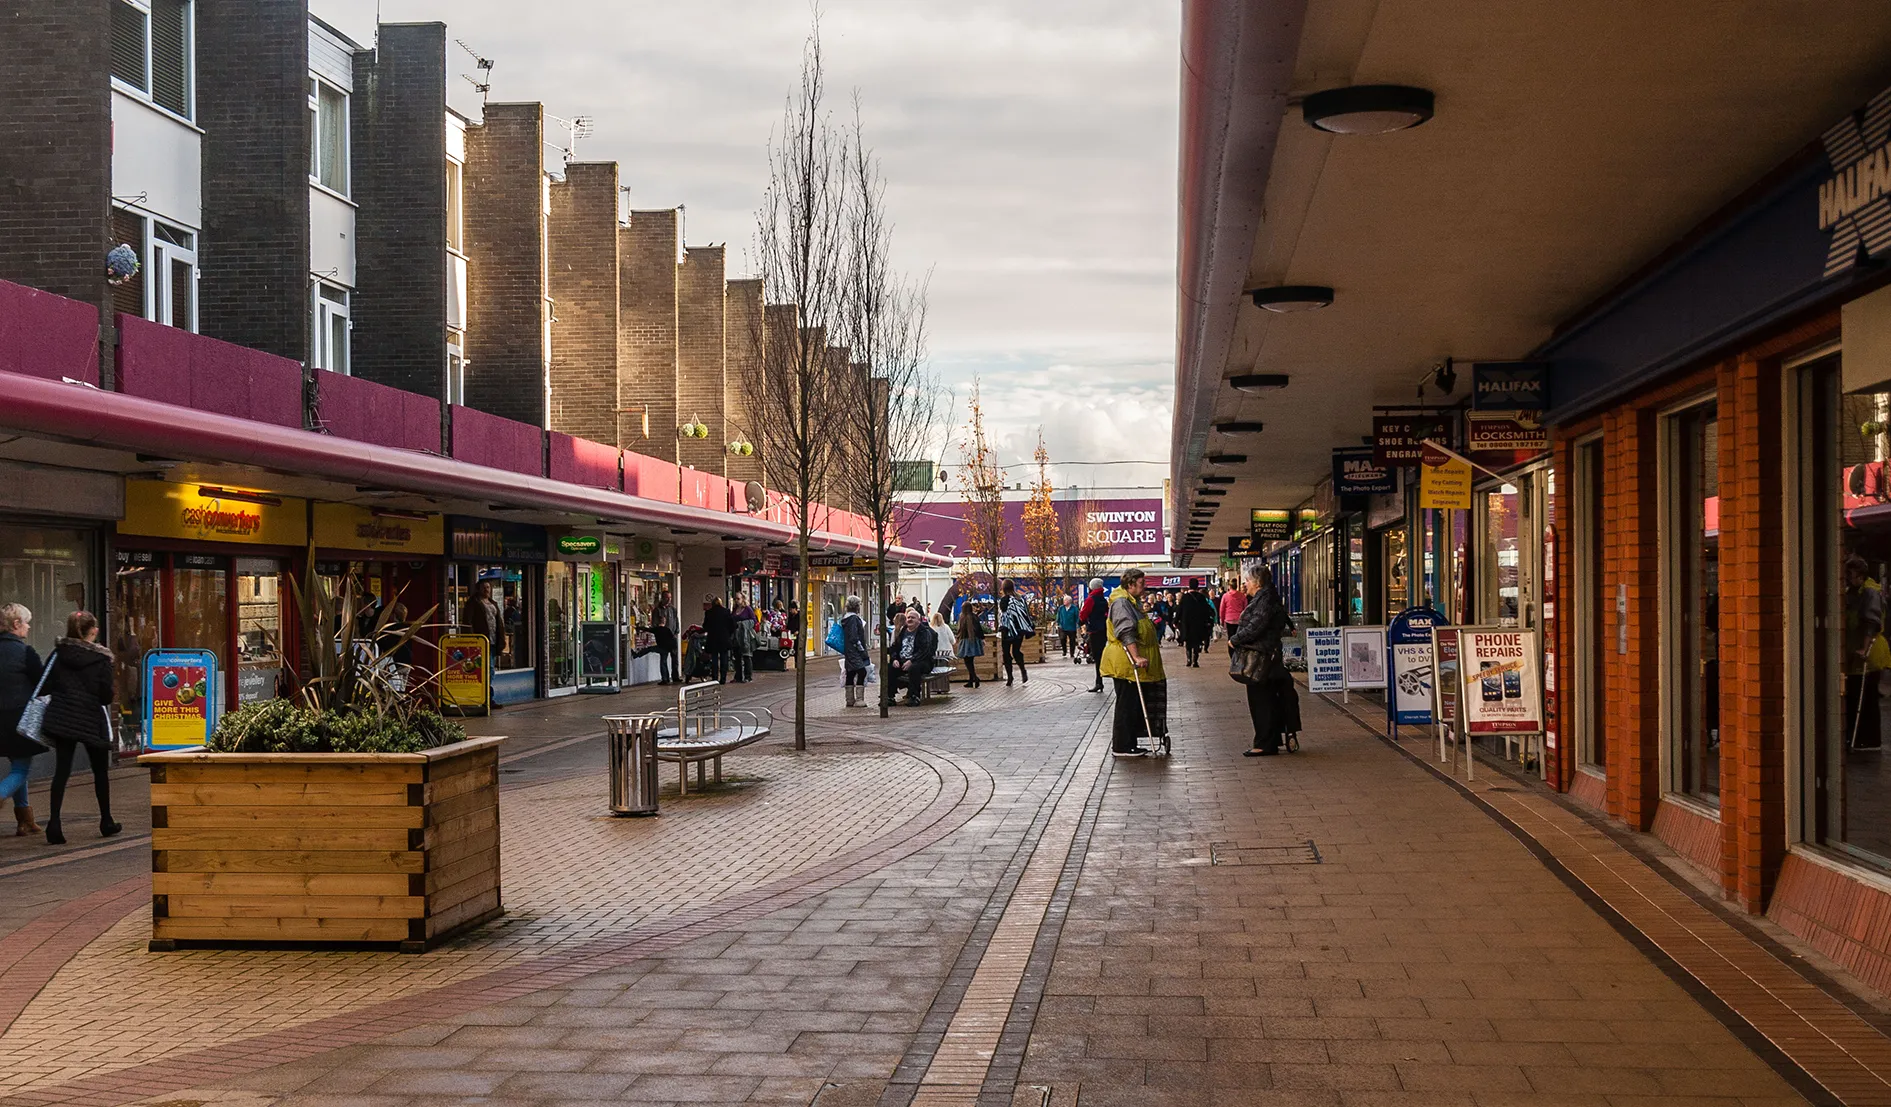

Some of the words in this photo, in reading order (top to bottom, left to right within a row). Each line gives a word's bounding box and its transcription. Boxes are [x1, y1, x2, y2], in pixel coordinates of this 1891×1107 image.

[1478, 380, 1542, 393] HALIFAX
[1381, 425, 1400, 433] KEY
[1474, 431, 1546, 441] LOCKSMITH
[1378, 437, 1403, 446] SHOE
[1385, 450, 1423, 459] ENGRAV
[1371, 484, 1391, 492] Expert
[1087, 511, 1156, 523] SWINTON
[453, 521, 503, 558] martins
[1087, 529, 1156, 544] SQUARE
[561, 540, 597, 548] Specsavers
[118, 551, 129, 564] buy
[811, 556, 850, 566] BETFRED
[1408, 618, 1432, 626] MAX
[1315, 638, 1340, 646] Mobile
[1474, 634, 1521, 647] PHONE
[1315, 648, 1340, 657] Laptop
[1476, 647, 1523, 657] REPAIRS
[1407, 655, 1416, 663] to
[1472, 668, 1494, 681] SPEEDY
[1494, 660, 1518, 674] SERVICE
